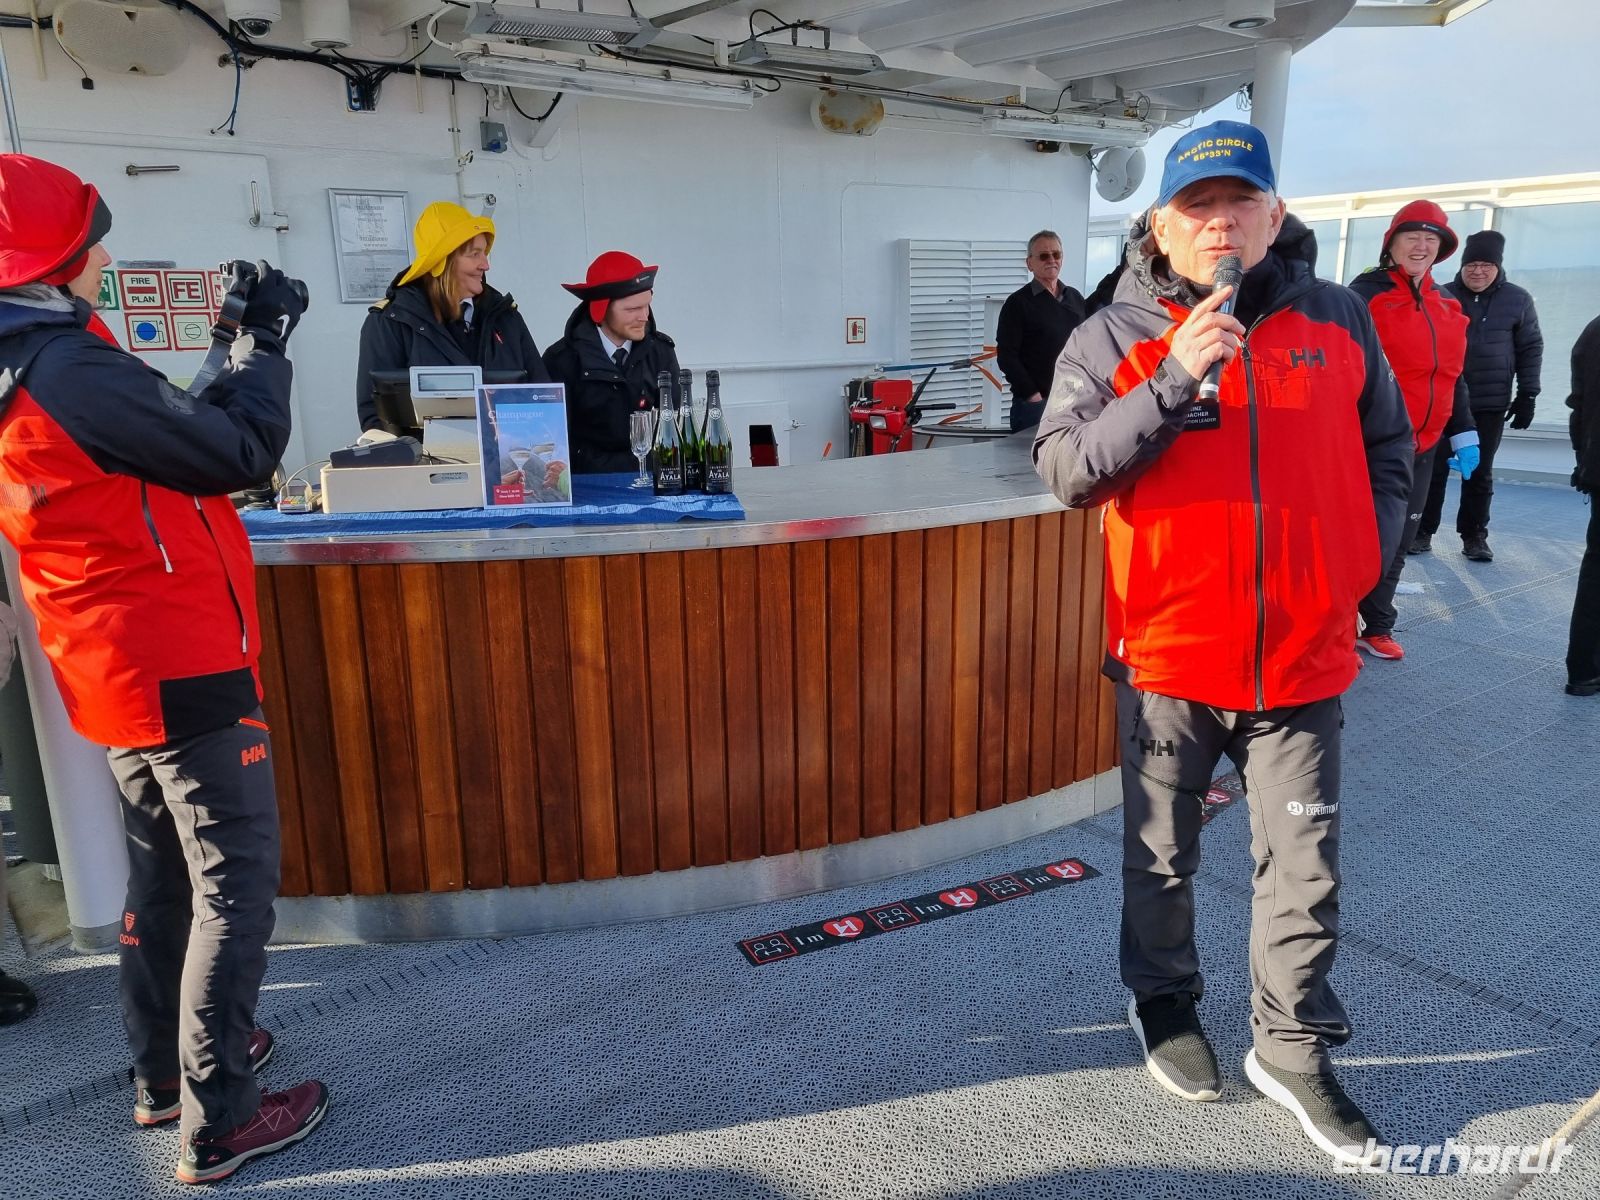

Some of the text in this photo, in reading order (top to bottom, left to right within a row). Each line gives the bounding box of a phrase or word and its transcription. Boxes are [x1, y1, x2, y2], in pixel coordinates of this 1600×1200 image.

[1177, 138, 1254, 163] ARCTIC CIRCLE
[130, 277, 151, 285] FIRE
[171, 281, 202, 299] FE
[131, 295, 155, 303] PLAN
[1289, 347, 1326, 368] HH
[660, 471, 682, 481] AYALA
[708, 470, 730, 479] AYALA
[241, 743, 266, 766] HH
[1139, 738, 1174, 756] HH
[119, 933, 140, 946] ODIN
